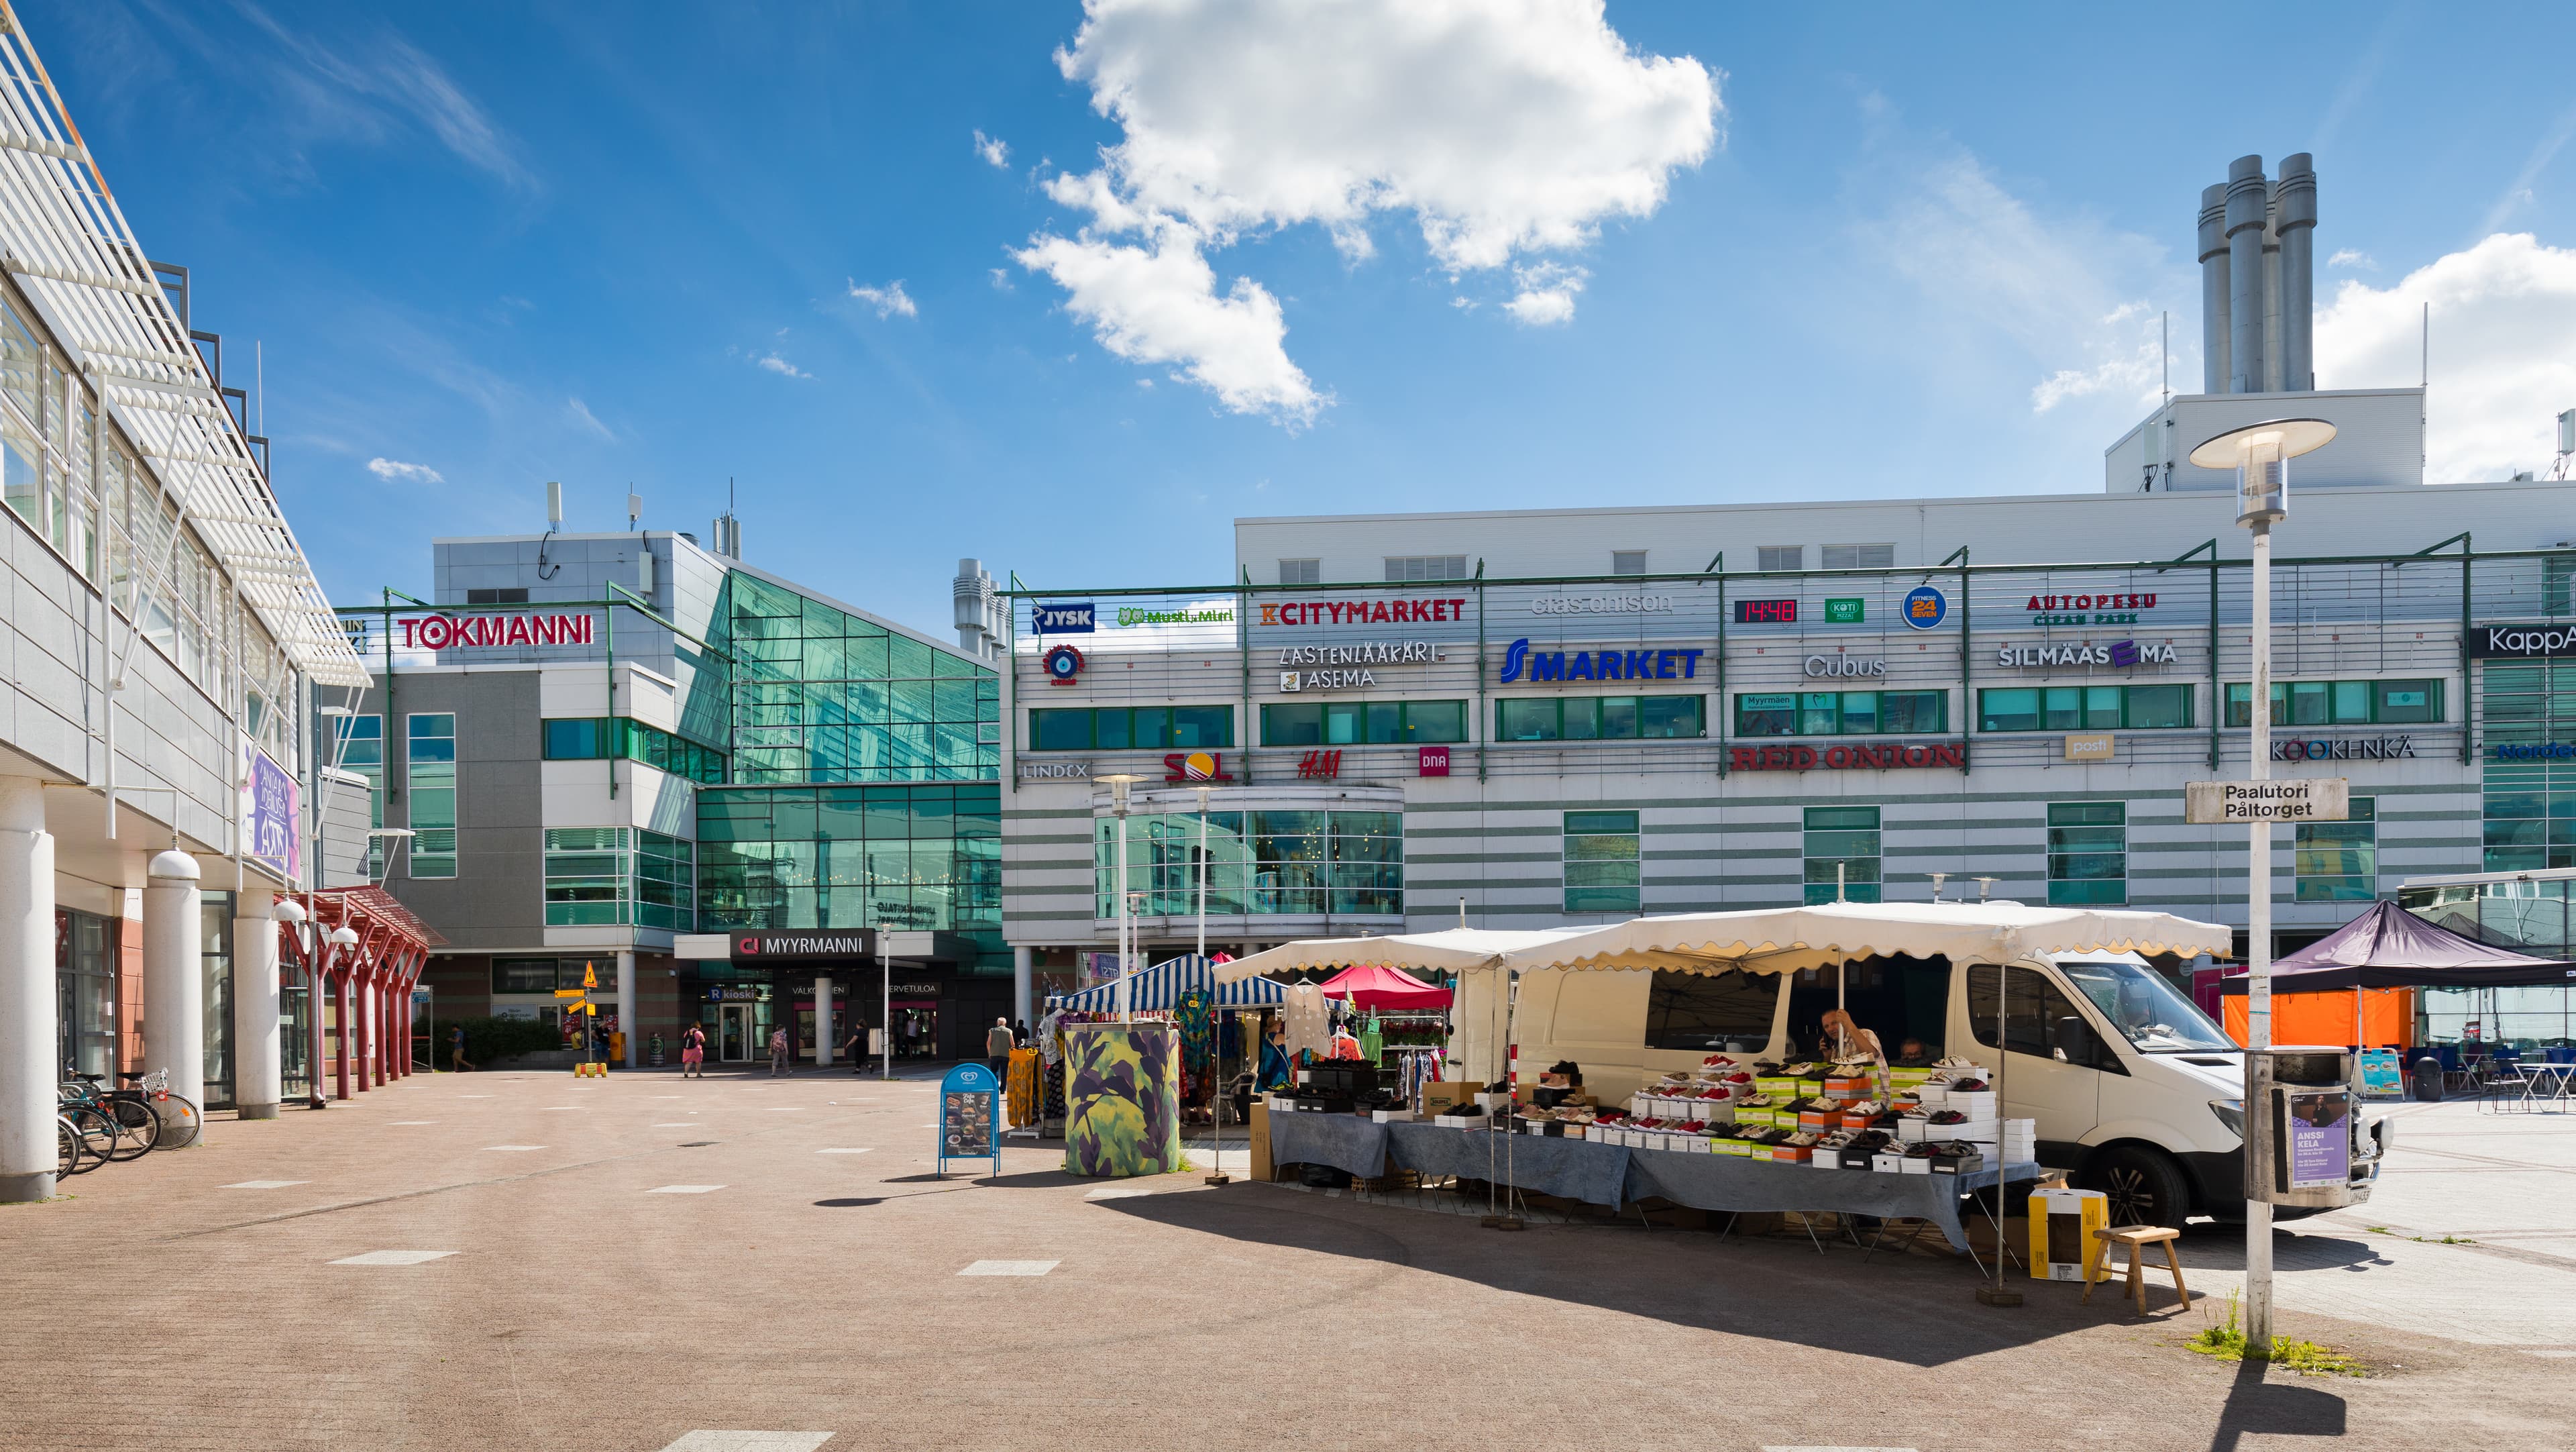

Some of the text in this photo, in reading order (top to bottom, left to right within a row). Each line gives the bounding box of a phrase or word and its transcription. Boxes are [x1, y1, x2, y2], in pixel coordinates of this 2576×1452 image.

[1531, 590, 1672, 615] clas ohlson
[1833, 604, 1856, 612] KOTI
[1912, 601, 1937, 611] 24
[2027, 593, 2157, 611] AUTOPESU
[1044, 611, 1092, 627] JYSK
[1147, 609, 1191, 623] Musti
[1199, 608, 1234, 622] Mirri
[1280, 599, 1466, 625] CITYMARKET
[1746, 601, 1794, 622] 14:48
[2033, 613, 2138, 625] CLEAN PARK
[398, 615, 594, 650] TOKMANNI
[1998, 639, 2178, 668] SILMÄASEMA
[1530, 649, 1704, 682] MARKET
[1805, 653, 1886, 678] Cubus
[1307, 668, 1376, 688] ASEMA
[1748, 695, 1790, 705] Myyrmäen
[2074, 739, 2107, 756] posti
[2271, 735, 2416, 760] KOOKENKÄ
[1297, 749, 1342, 779] H&M
[1423, 756, 1446, 768] DNA
[1730, 744, 1966, 771] RED ONION
[1023, 764, 1088, 778] LINDEX
[1164, 752, 1233, 781] SOL
[2226, 784, 2308, 799] Paalutori
[2226, 801, 2312, 819] Påltorget
[766, 937, 863, 953] MYYRMANNI
[723, 988, 755, 999] kioski
[792, 986, 845, 994] VÄLKEN
[888, 985, 936, 993] ERVETULOA
[2298, 1131, 2324, 1140] ANSSI
[2298, 1140, 2319, 1148] KELA
